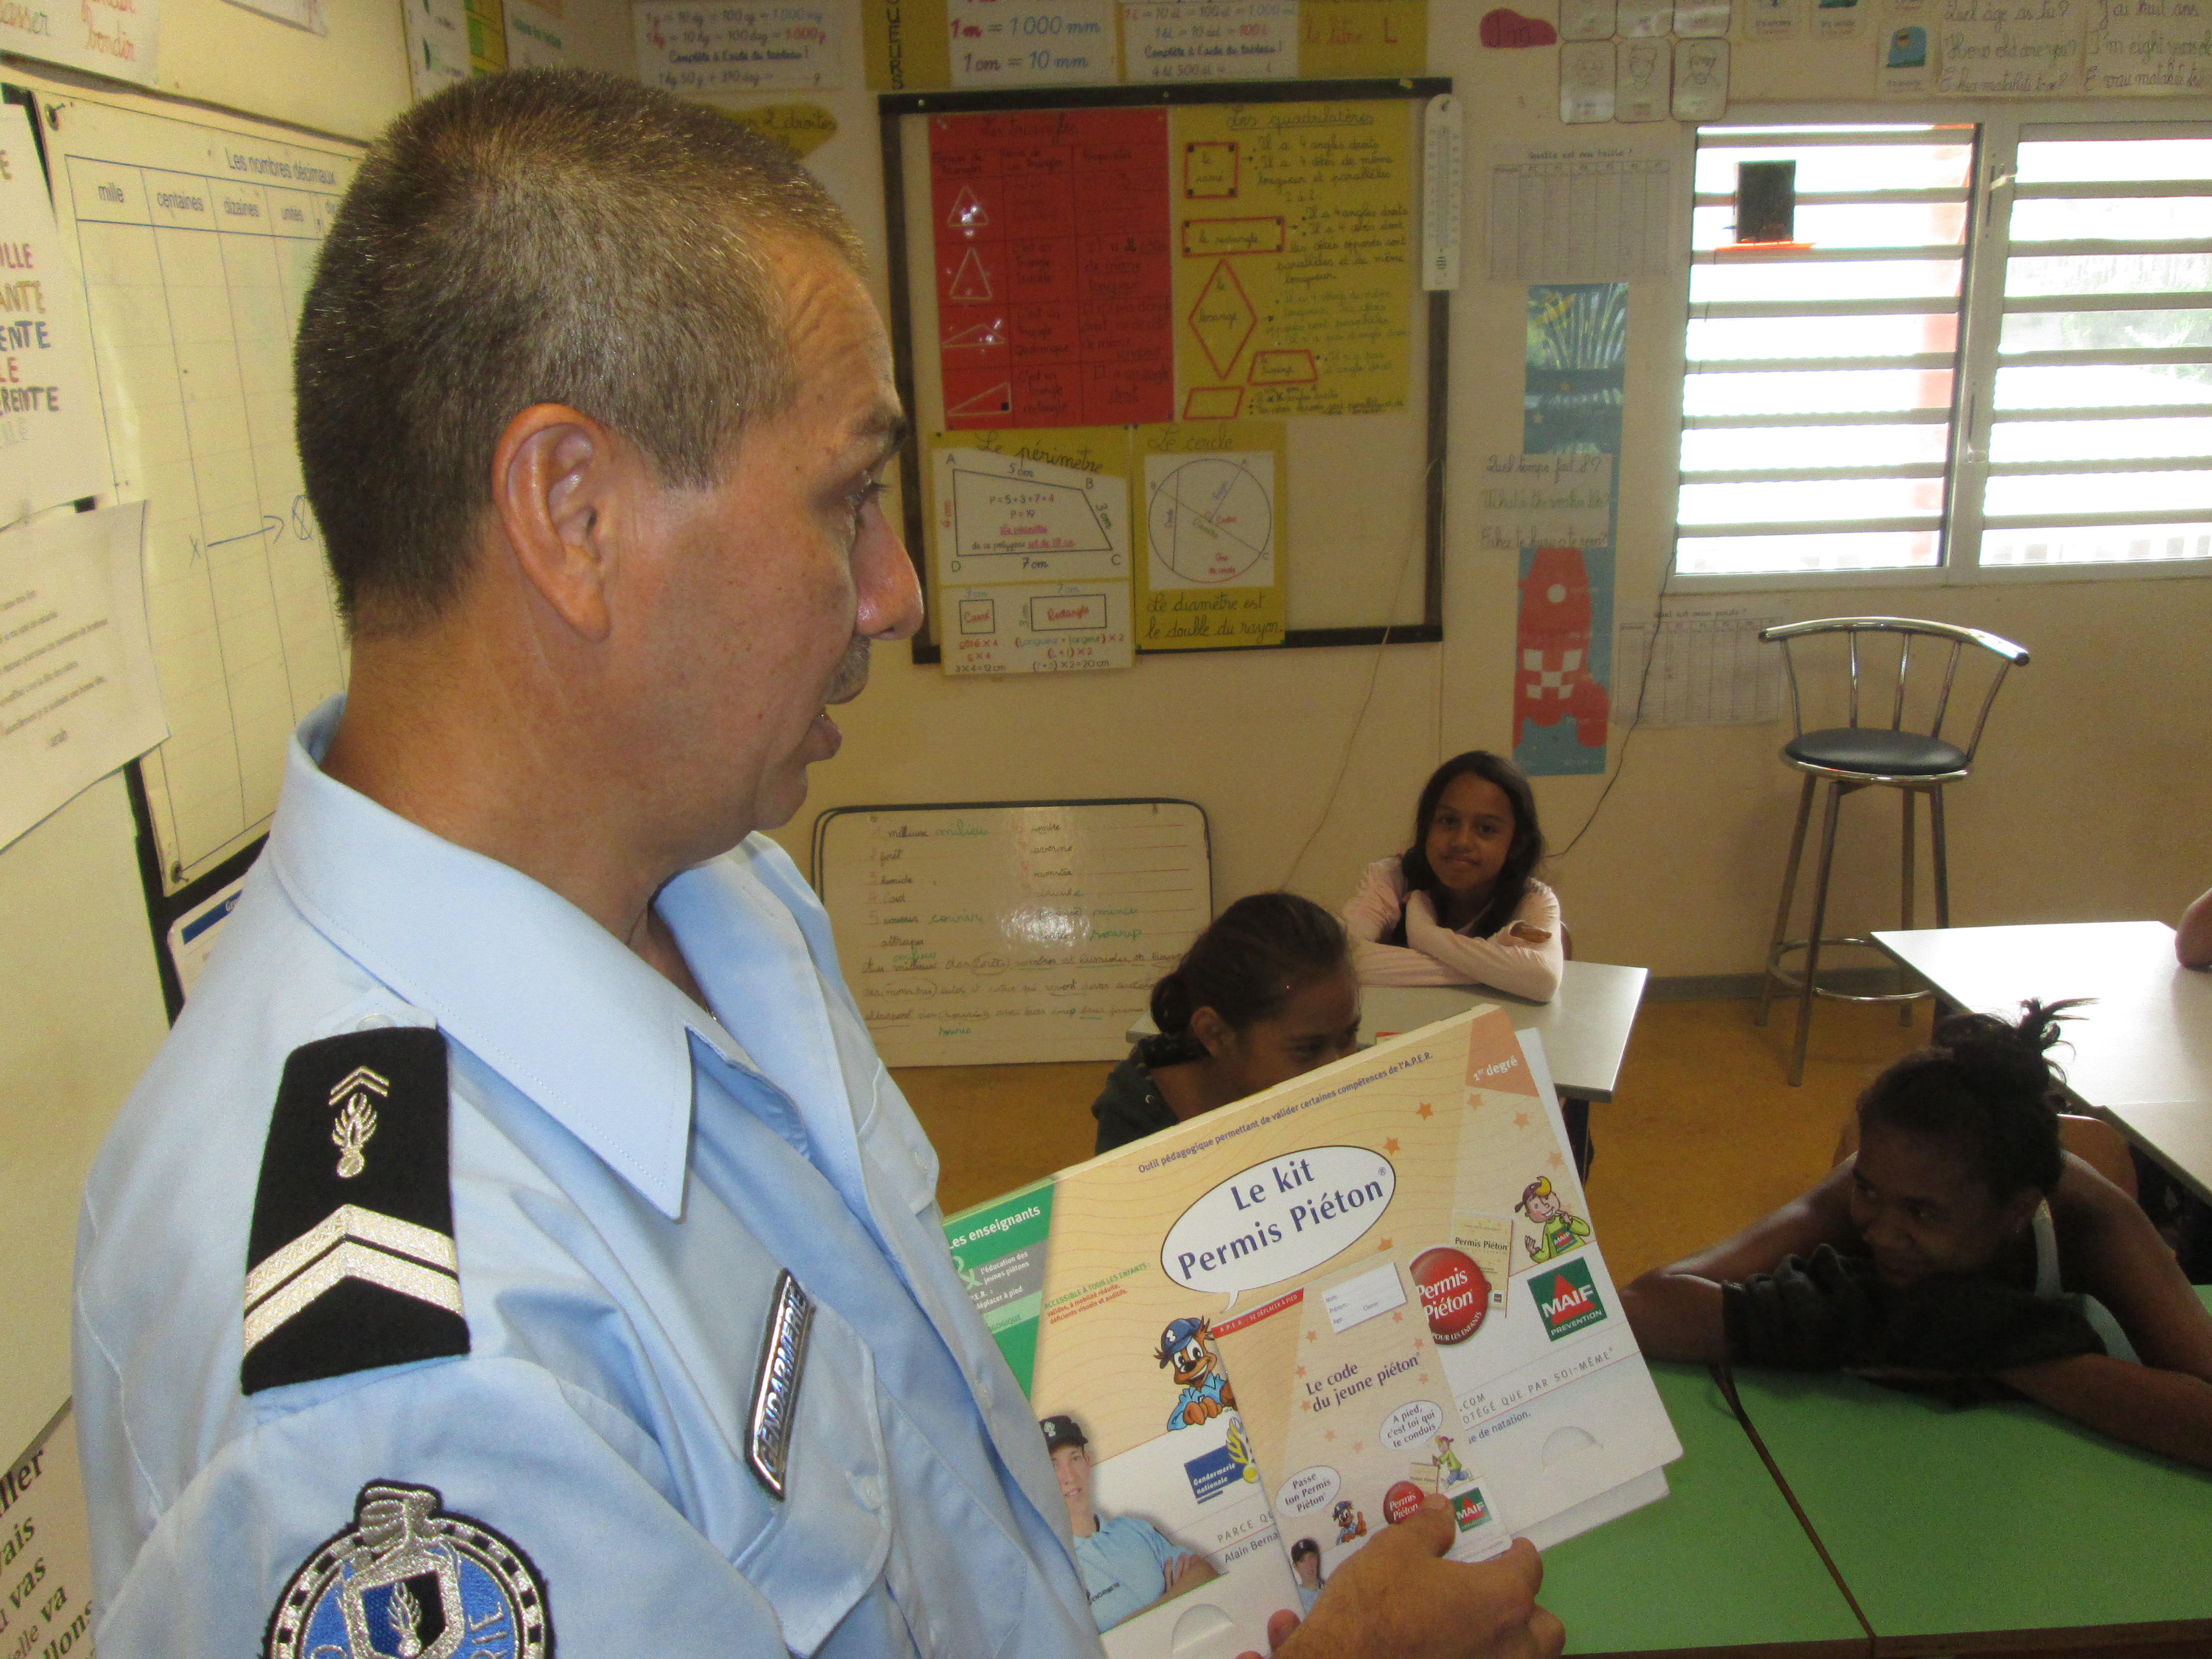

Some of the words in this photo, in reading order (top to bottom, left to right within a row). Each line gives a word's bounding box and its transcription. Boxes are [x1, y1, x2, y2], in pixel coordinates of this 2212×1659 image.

[1068, 20, 1101, 34] mm
[964, 53, 972, 72] 1
[975, 59, 1000, 72] cm
[1029, 50, 1049, 69] 10
[1056, 57, 1088, 69] mm
[225, 147, 247, 171] Les
[248, 155, 292, 179] nombres
[293, 161, 337, 185] décimaux
[97, 182, 125, 204] mille
[156, 190, 204, 213] centaines
[975, 431, 1002, 453] Le
[946, 453, 955, 465] A
[1007, 463, 1017, 474] 5
[1017, 467, 1034, 478] cm
[1085, 478, 1094, 490] B
[951, 560, 961, 572] D
[1022, 556, 1031, 568] 7
[1031, 557, 1049, 568] cm
[1111, 553, 1121, 566] C
[1047, 604, 1090, 622] Rectangle
[1165, 616, 1210, 637] double
[1215, 618, 1235, 636] du
[1486, 1055, 1518, 1076] degré
[1138, 1159, 1159, 1173] Outil
[1161, 1139, 1214, 1166] pédagogique
[1215, 1120, 1260, 1144] permettant
[1261, 1116, 1271, 1125] de
[1272, 1104, 1298, 1120] valider
[1300, 1090, 1336, 1109] certaines
[1337, 1070, 1388, 1095] compétences
[1388, 1065, 1398, 1075] de
[1230, 1183, 1266, 1211] Le
[1272, 1159, 1315, 1193] kit
[969, 1206, 1041, 1242] enseignants
[1455, 1237, 1481, 1247] Permis
[1483, 1240, 1507, 1250] Piéton
[1554, 1231, 1572, 1245] MAIF
[1177, 1221, 1283, 1280] Permis
[980, 1256, 1016, 1274] l'éducation
[1016, 1251, 1029, 1261] des
[983, 1268, 1006, 1285] jeunes
[1006, 1261, 1030, 1276] piétons
[1009, 1286, 1023, 1298] pied
[1043, 1288, 1082, 1309] ACCESSIBLE
[1089, 1280, 1105, 1291] TOUS
[1105, 1274, 1118, 1284] LES
[1119, 1263, 1147, 1279] ENFANTS
[1416, 1267, 1468, 1299] Permis
[1046, 1303, 1070, 1317] valides,
[1075, 1292, 1097, 1305] mobilité
[1257, 1300, 1281, 1318] DÉPLACER
[1287, 1294, 1298, 1304] PIED
[1423, 1291, 1473, 1323] Piéton
[1541, 1284, 1594, 1318] MAIF
[1049, 1310, 1078, 1324] déficients
[1078, 1302, 1098, 1314] visuels
[1551, 1310, 1602, 1335] PREVENTION
[1451, 1331, 1461, 1340] LES
[1461, 1311, 1482, 1335] ENFANTS
[759, 1286, 806, 1474] GENDARMERIE
[1306, 1381, 1323, 1395] Le
[1327, 1363, 1358, 1385] code
[1312, 1396, 1331, 1412] du
[1334, 1377, 1373, 1406] jeune
[1377, 1356, 1419, 1386] piéton
[1502, 1390, 1523, 1406] QUE
[1528, 1378, 1548, 1393] PAR
[1387, 1425, 1406, 1438] c'est
[1407, 1419, 1419, 1429] toi
[1421, 1411, 1435, 1423] qui
[1401, 1406, 1422, 1421] pied,
[1404, 1423, 1436, 1443] conduis
[1479, 1428, 1489, 1440] de
[1491, 1410, 1531, 1433] natation.
[1193, 1463, 1236, 1485] Gendarmerie
[1292, 1473, 1316, 1489] Passe
[1197, 1477, 1228, 1494] nationale
[1285, 1494, 1299, 1505] ton
[1301, 1479, 1331, 1496] Permis
[1297, 1495, 1324, 1512] Piéton
[1389, 1492, 1417, 1511] Permis
[1393, 1503, 1418, 1521] Piéton
[1456, 1502, 1484, 1519] MAIF
[1217, 1520, 1254, 1543] PARCE
[1225, 1547, 1248, 1563] Alain
